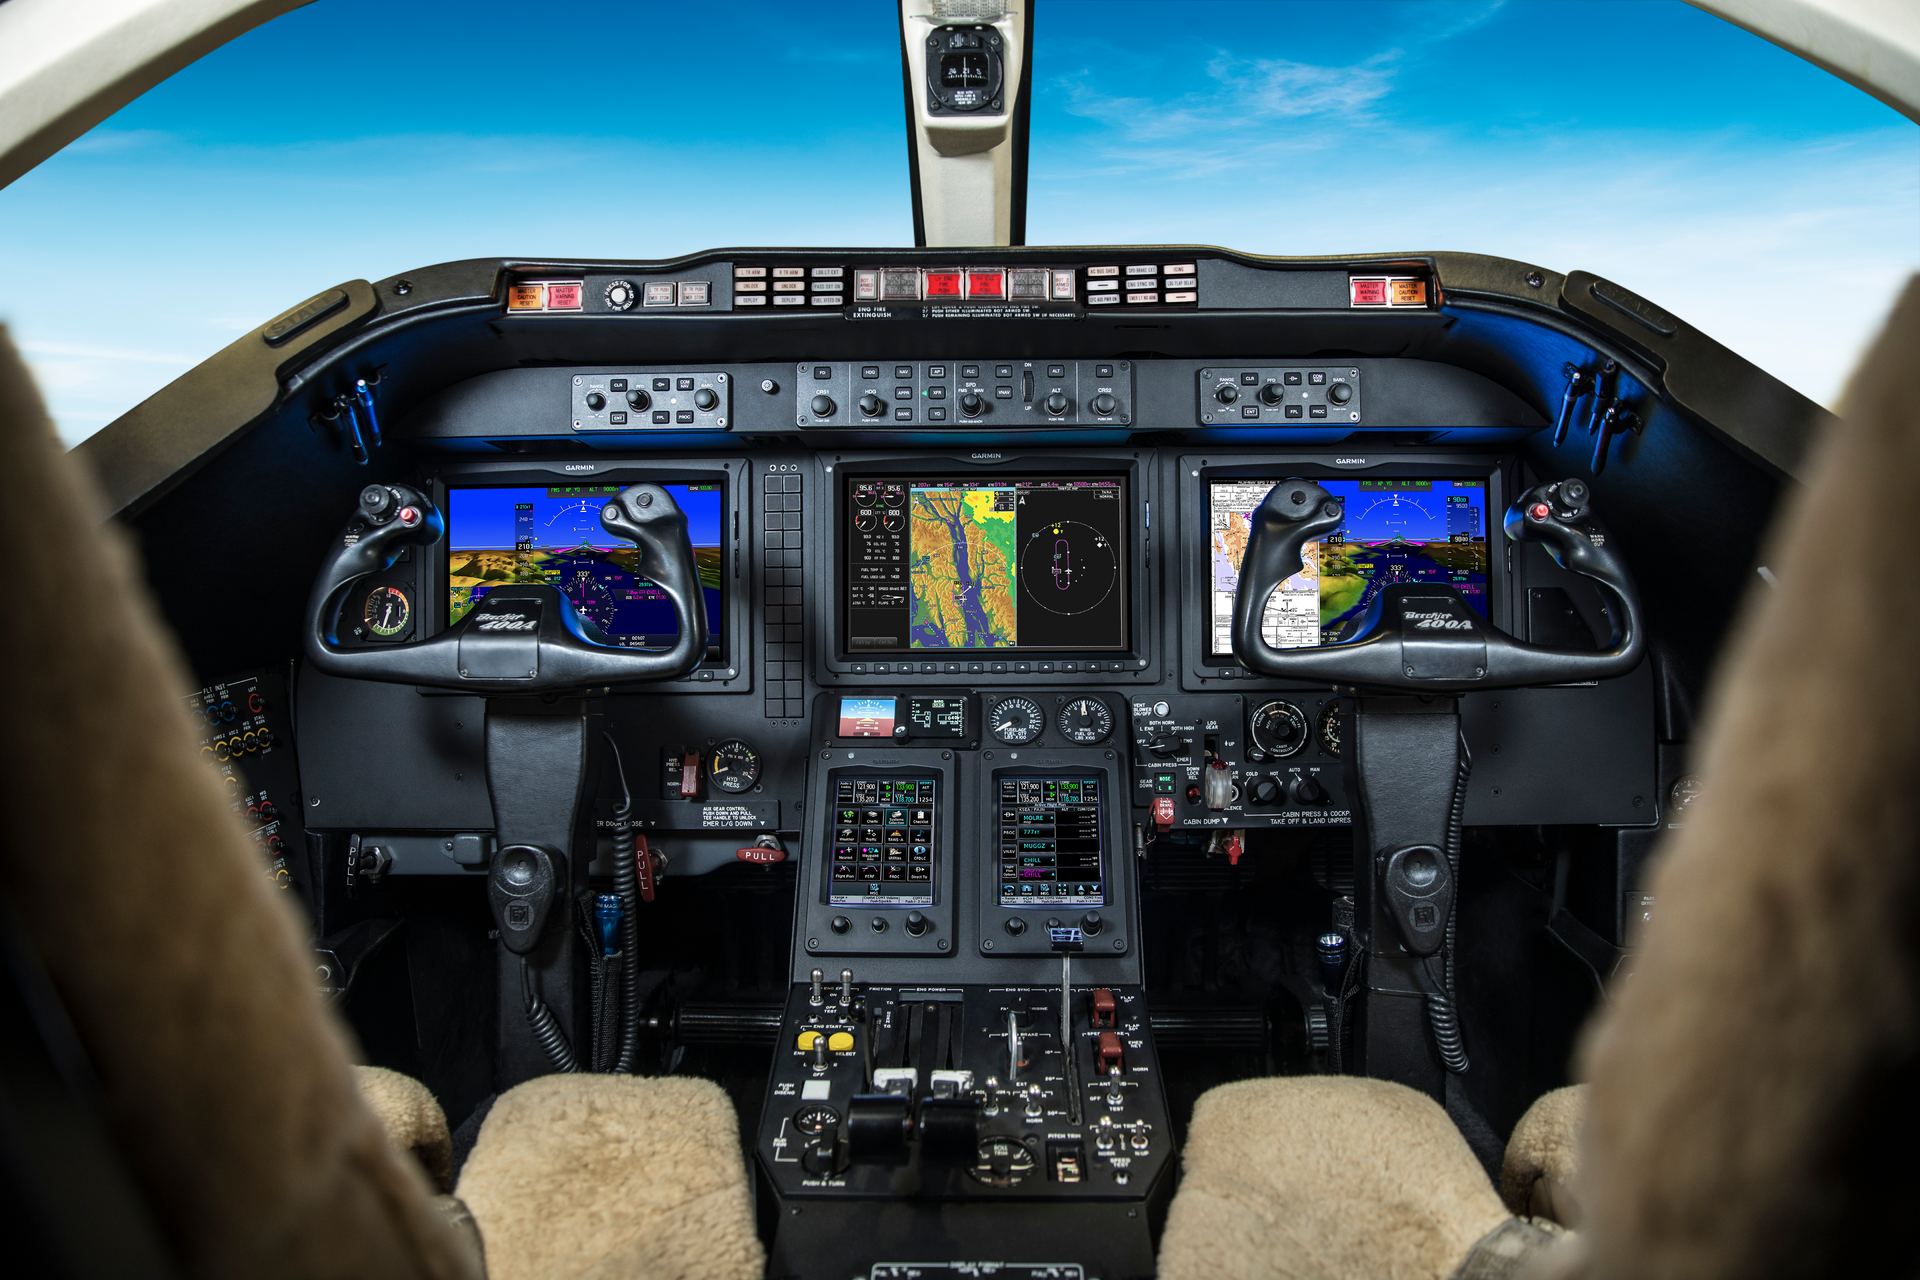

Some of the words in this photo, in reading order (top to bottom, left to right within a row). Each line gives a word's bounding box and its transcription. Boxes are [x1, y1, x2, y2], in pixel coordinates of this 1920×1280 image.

[478, 619, 537, 632] 400A
[1415, 620, 1474, 630] 400A
[722, 781, 740, 789] PRESS
[745, 852, 775, 860] PULL
[347, 846, 356, 886] PULL
[637, 850, 648, 890] PULL
